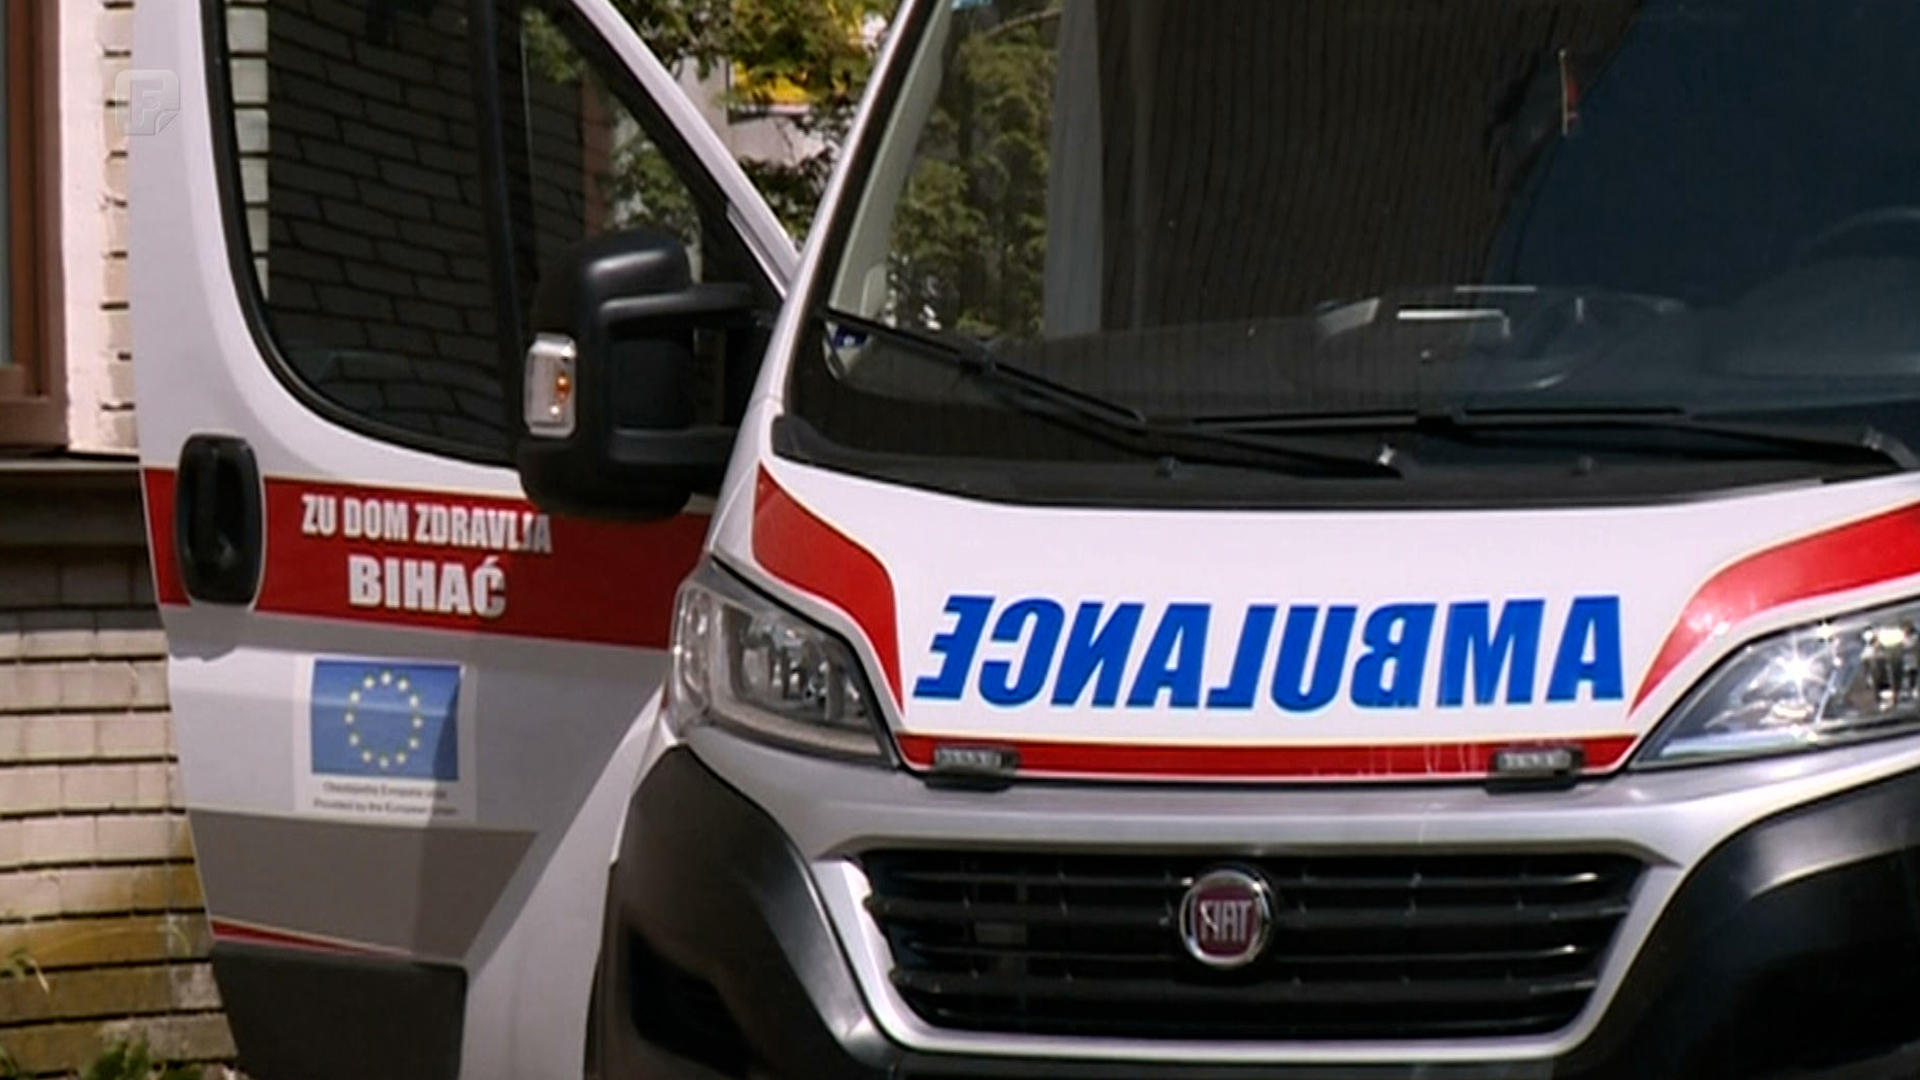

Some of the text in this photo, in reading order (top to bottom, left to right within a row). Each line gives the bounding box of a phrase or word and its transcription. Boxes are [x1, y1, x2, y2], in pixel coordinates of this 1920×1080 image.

[302, 494, 552, 553] ZU DOM ZDRAVLJA
[349, 555, 506, 618] BIHAĆ
[1201, 900, 1252, 942] FIAT
